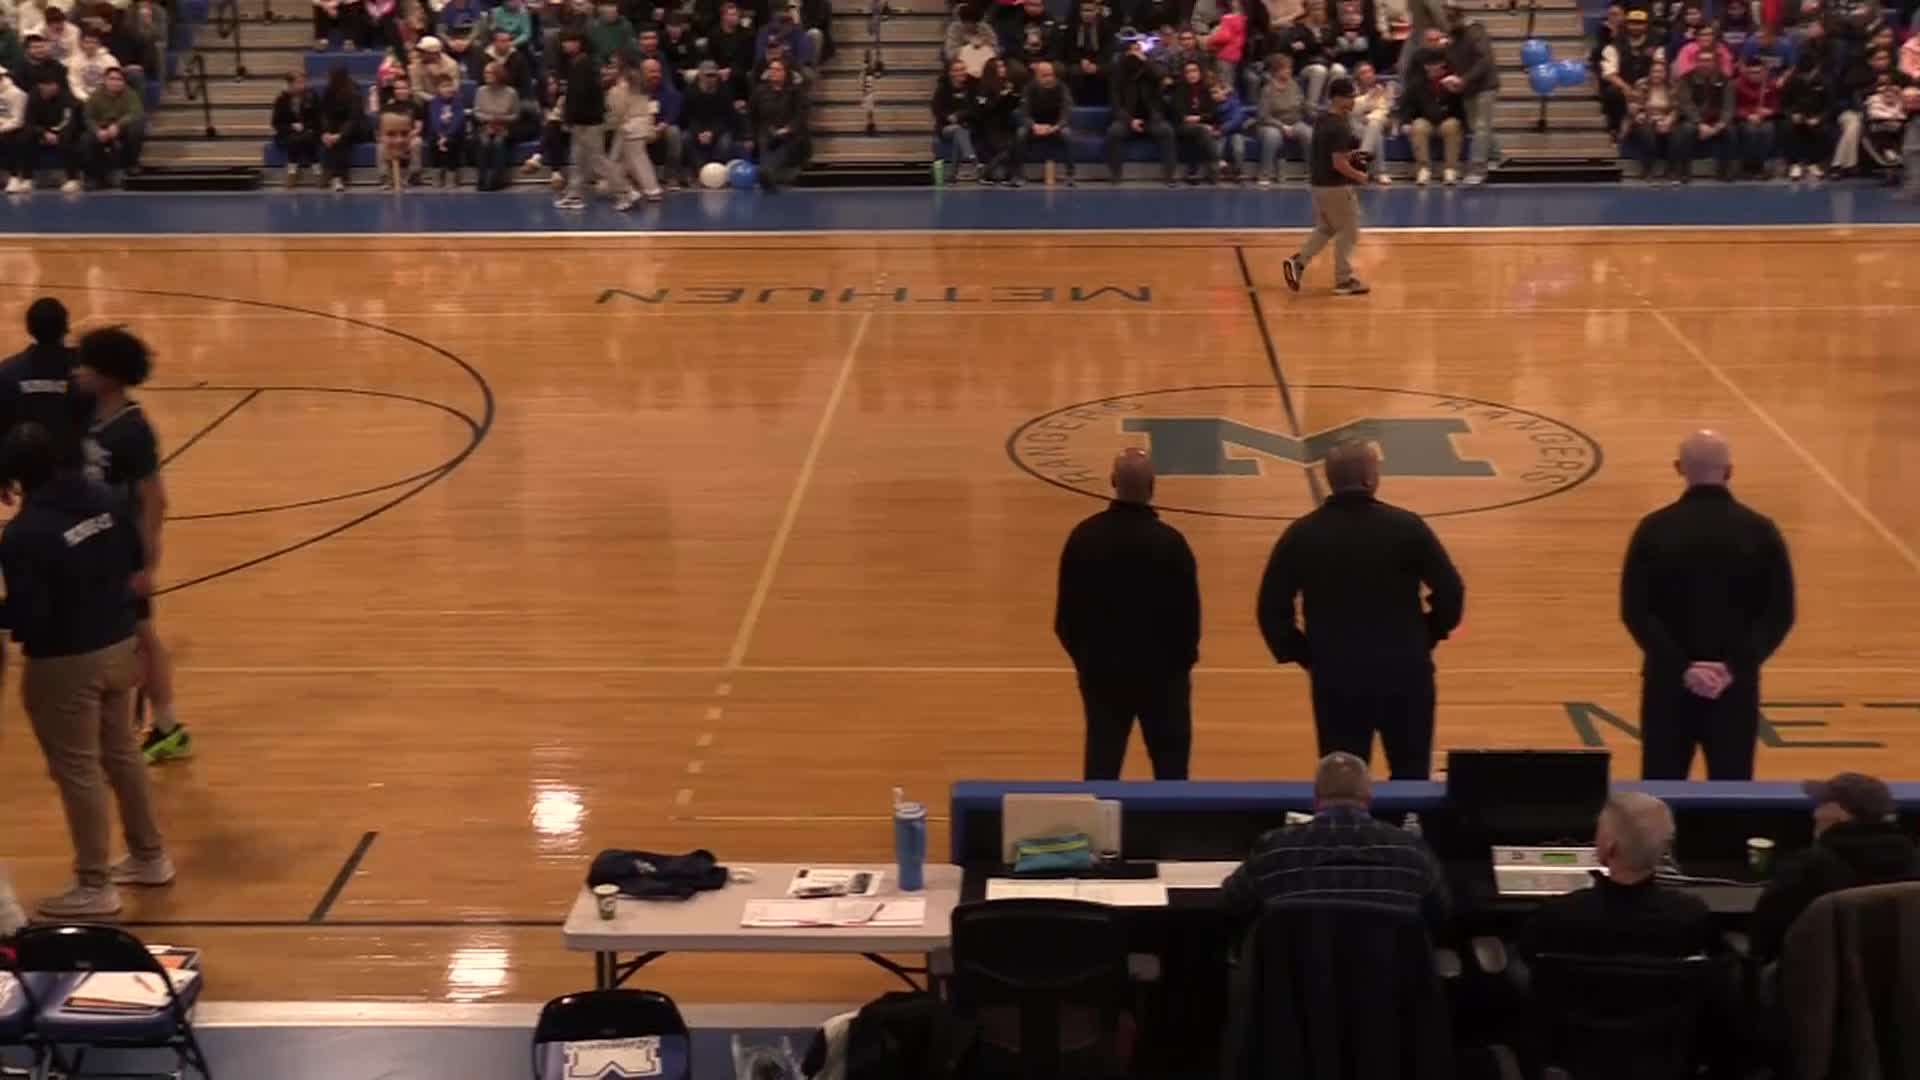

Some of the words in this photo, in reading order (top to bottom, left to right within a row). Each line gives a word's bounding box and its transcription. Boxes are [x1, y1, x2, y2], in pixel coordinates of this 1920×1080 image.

[595, 286, 1152, 304] METHUEN
[1023, 400, 1143, 484] RANGERS
[1121, 416, 1497, 478] M
[1431, 400, 1586, 484] RANGERS
